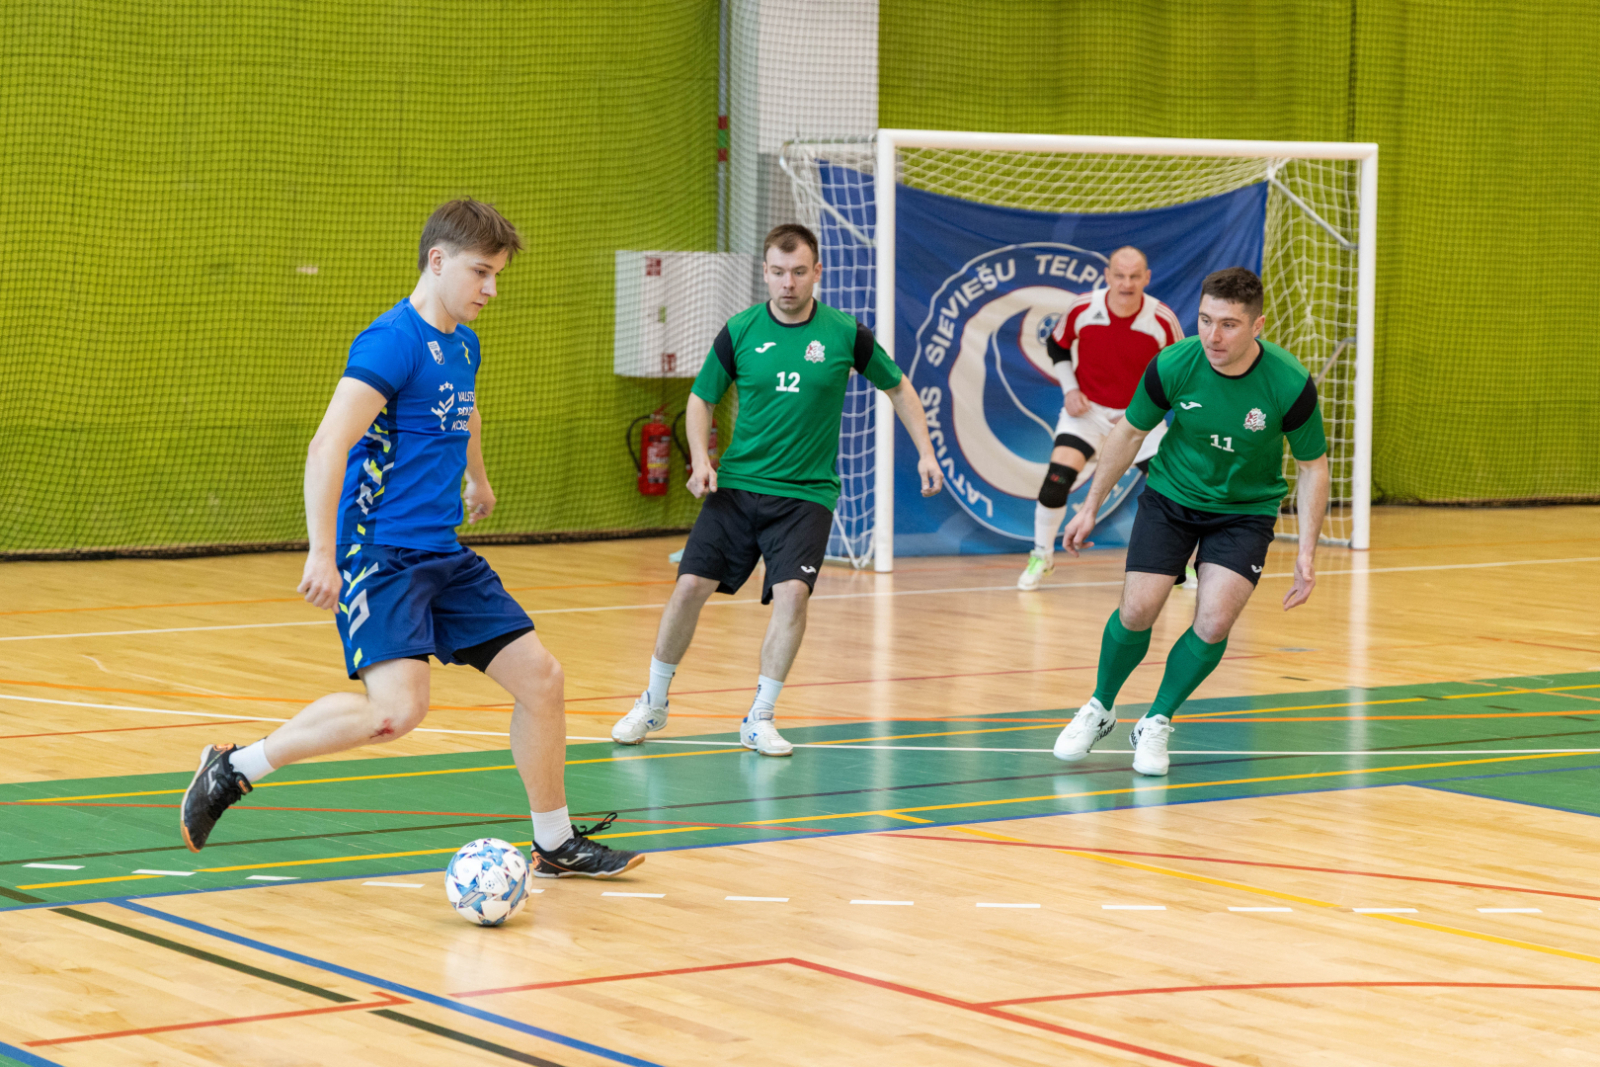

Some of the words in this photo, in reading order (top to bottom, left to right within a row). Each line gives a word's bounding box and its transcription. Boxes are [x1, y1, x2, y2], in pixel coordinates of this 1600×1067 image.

[925, 258, 1016, 367] SIEVIEŠU
[775, 371, 801, 393] 12
[1210, 434, 1235, 453] 11
